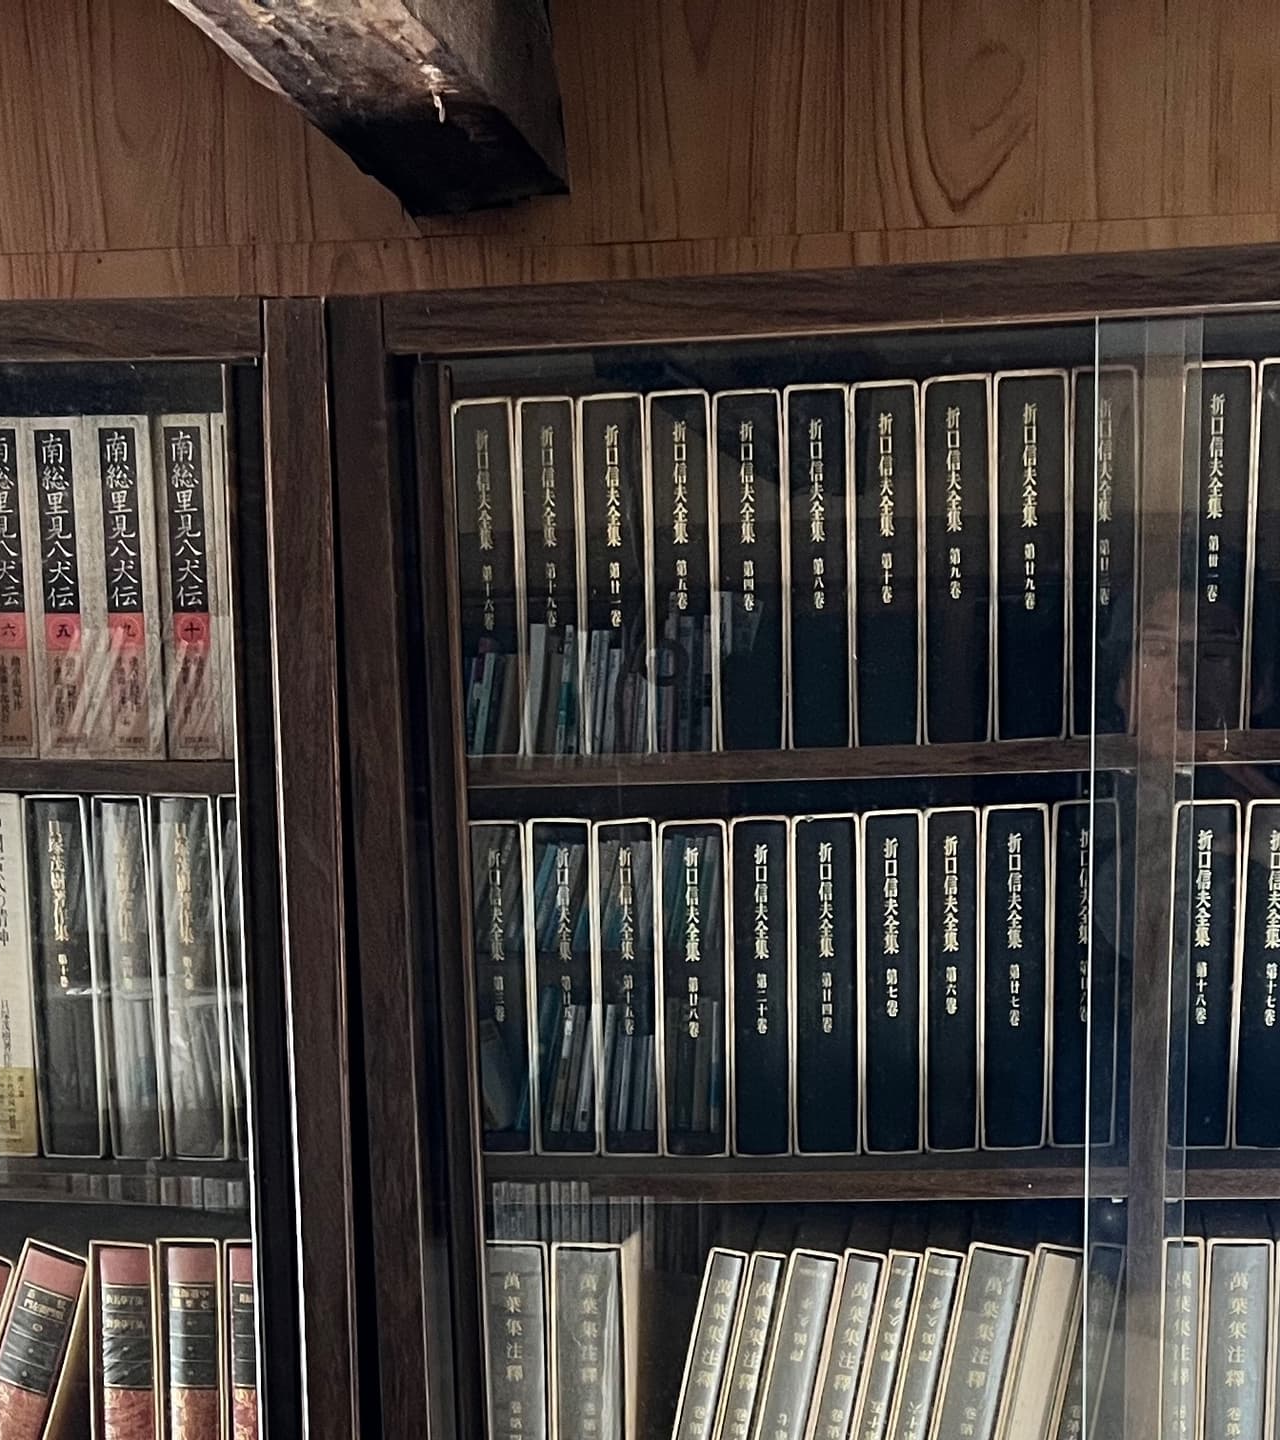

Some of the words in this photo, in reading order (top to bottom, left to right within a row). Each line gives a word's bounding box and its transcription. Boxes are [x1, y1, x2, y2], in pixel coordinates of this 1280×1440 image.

[809, 418, 825, 543] 折口信夫全集
[878, 412, 895, 537] 折口信夫全集
[946, 405, 962, 532] 折口信夫全集
[1021, 402, 1038, 528] 折口信夫全集
[1206, 393, 1226, 520] 折口信夫全集
[41, 433, 75, 608] 南総里見八犬伝
[106, 433, 138, 608] 南総里見八犬伝
[171, 431, 204, 608] 南総里見八犬伝
[684, 847, 700, 962] 折口信夫全集
[754, 844, 770, 960] 折口信夫全集
[819, 842, 834, 958] 折口信夫全集
[883, 837, 900, 955] 折口信夫全集
[943, 835, 960, 952] 折口信夫全集
[1007, 832, 1023, 949] 折口信夫全集
[1194, 829, 1214, 948] 折口信夫全集
